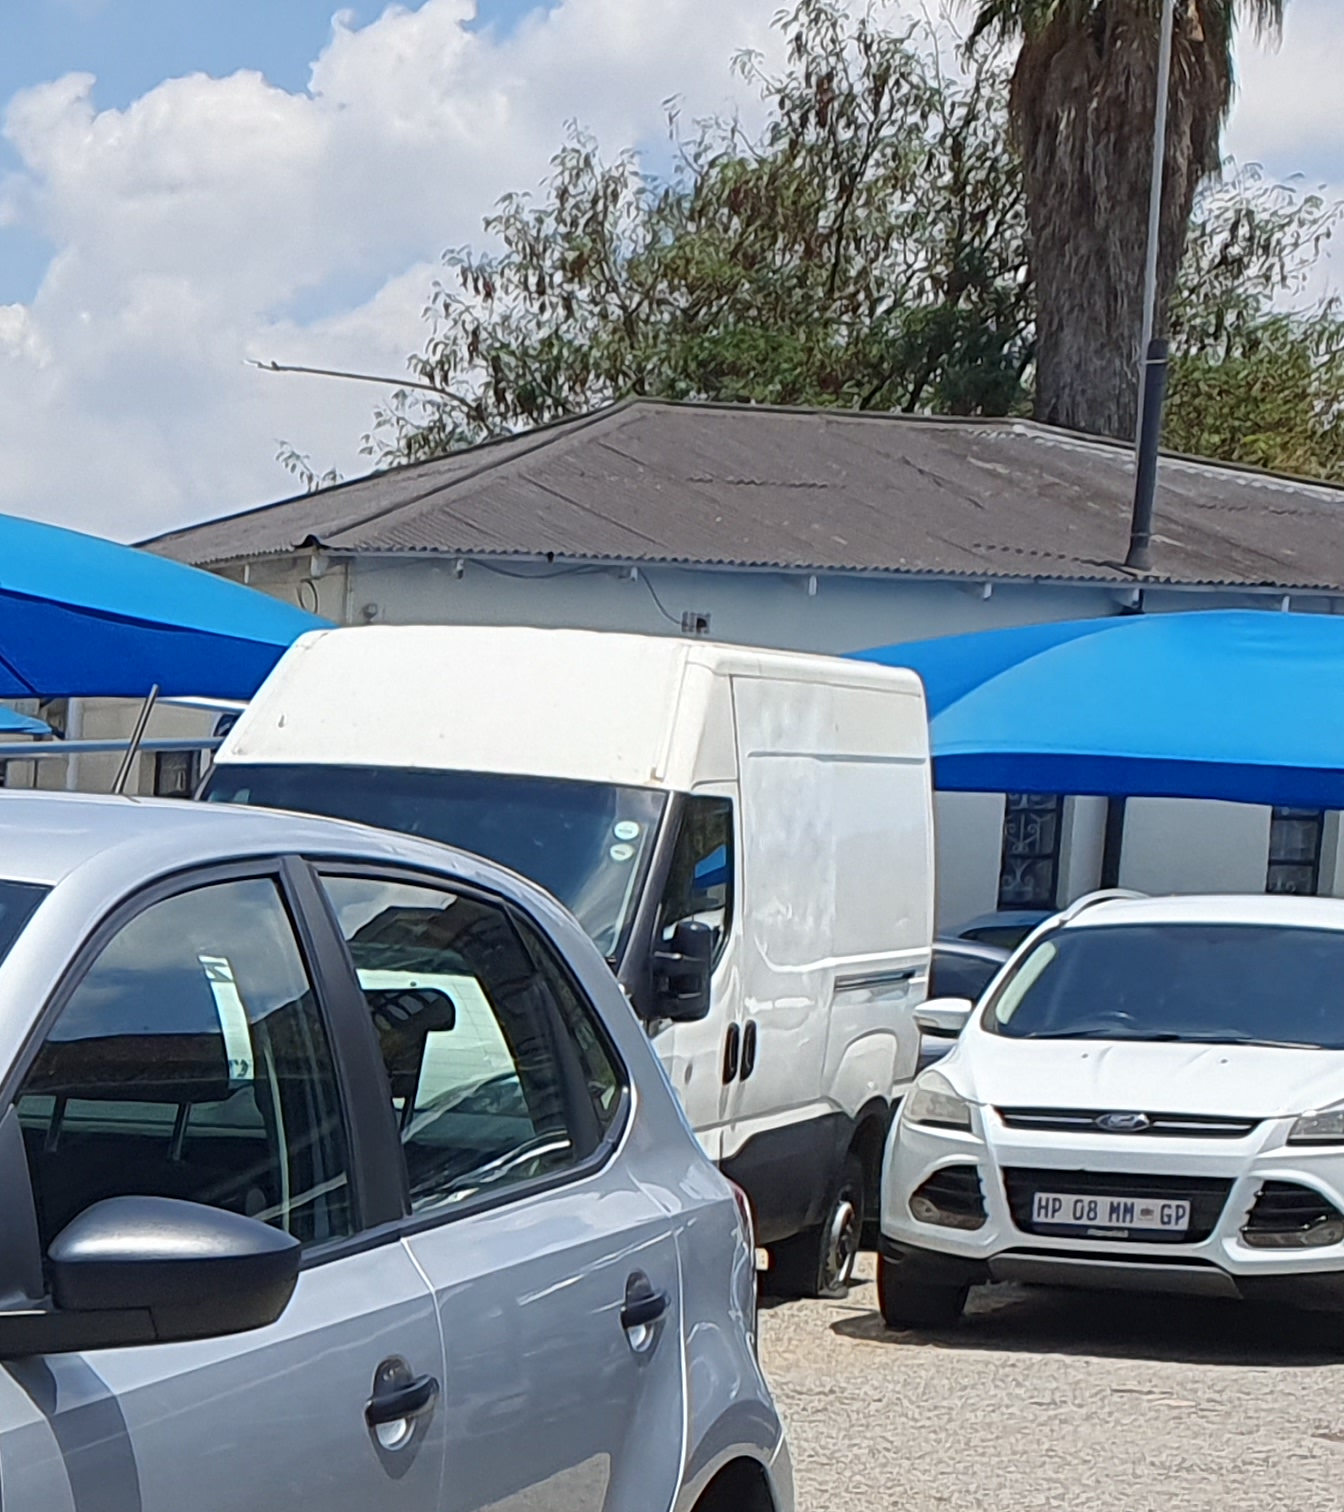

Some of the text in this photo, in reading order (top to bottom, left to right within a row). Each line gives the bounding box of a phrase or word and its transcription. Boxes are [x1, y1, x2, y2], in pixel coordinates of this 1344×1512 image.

[1036, 1196, 1187, 1226] HP 08 MM GP
